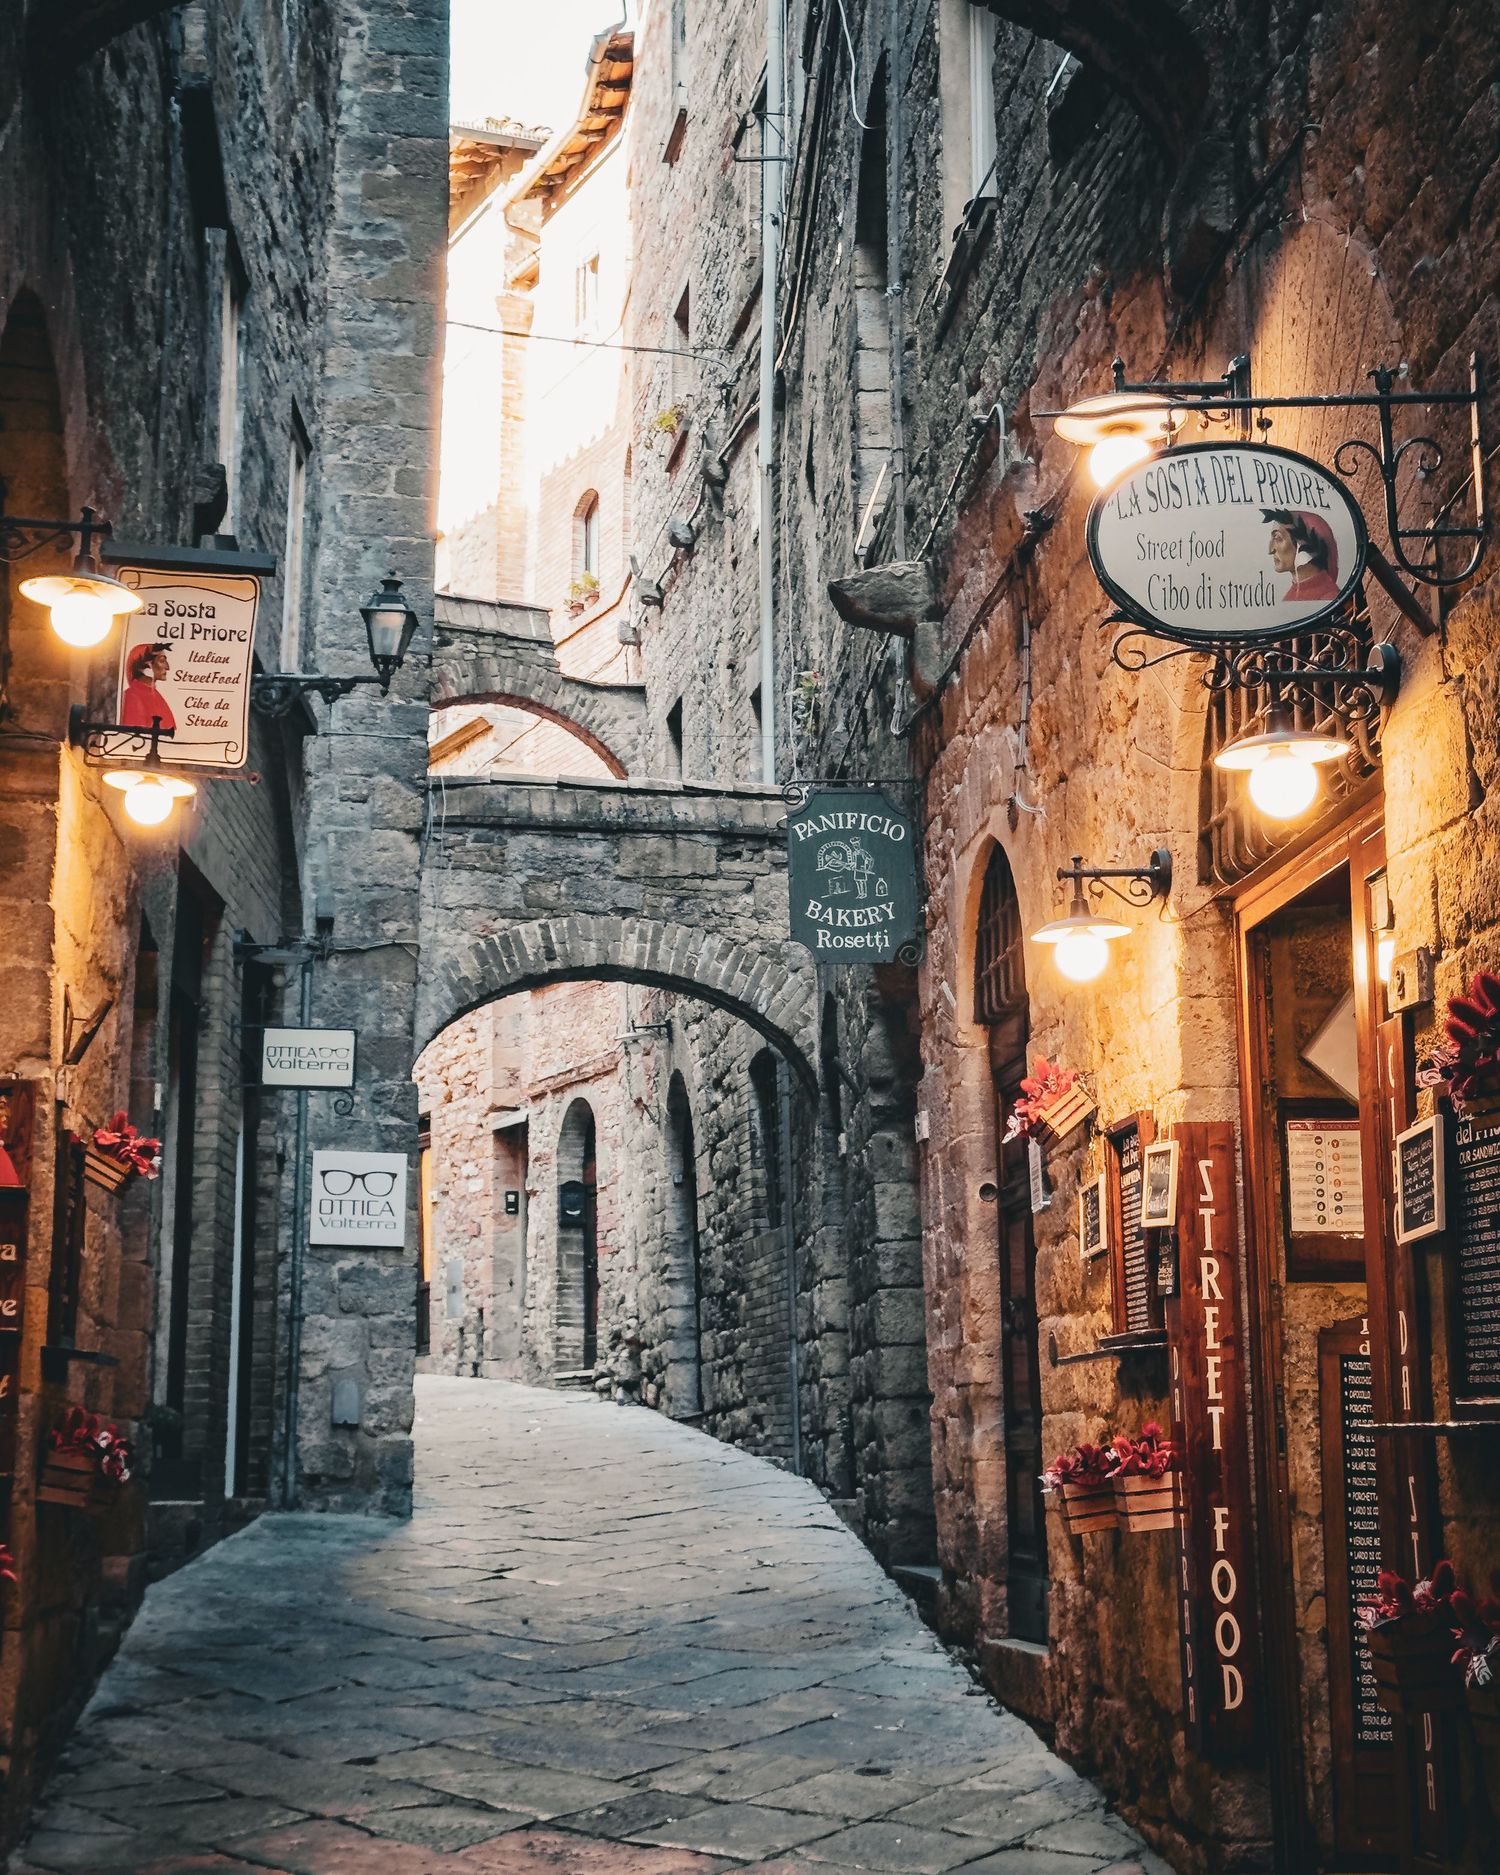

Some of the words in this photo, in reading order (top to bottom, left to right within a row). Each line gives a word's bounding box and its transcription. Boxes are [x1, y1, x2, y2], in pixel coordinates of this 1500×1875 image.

[1145, 457, 1210, 513] SOSTA
[1210, 455, 1254, 505] DEL
[1136, 532, 1183, 561] Street
[1186, 530, 1225, 567] food
[1147, 572, 1190, 612] Cibo
[1195, 572, 1213, 610] di
[1218, 570, 1276, 608] strada
[164, 599, 216, 619] Sosta
[157, 621, 185, 640] del
[190, 623, 248, 643] Priore
[188, 650, 230, 664] Italian
[184, 696, 210, 710] Cibo
[214, 697, 230, 711] da
[185, 713, 229, 728] Strada
[791, 812, 905, 842] PANIFICIO
[804, 899, 896, 927] BAKERY
[266, 1046, 317, 1059] OTTICA
[266, 1057, 349, 1071] Volterra
[1455, 1122, 1472, 1146] del
[1459, 1150, 1471, 1165] OUR
[318, 1198, 395, 1217] OTTICA
[319, 1216, 397, 1230] Volterra
[1199, 1159, 1226, 1450] STREET
[1399, 1310, 1411, 1411] DA
[1211, 1507, 1244, 1711] FOOD
